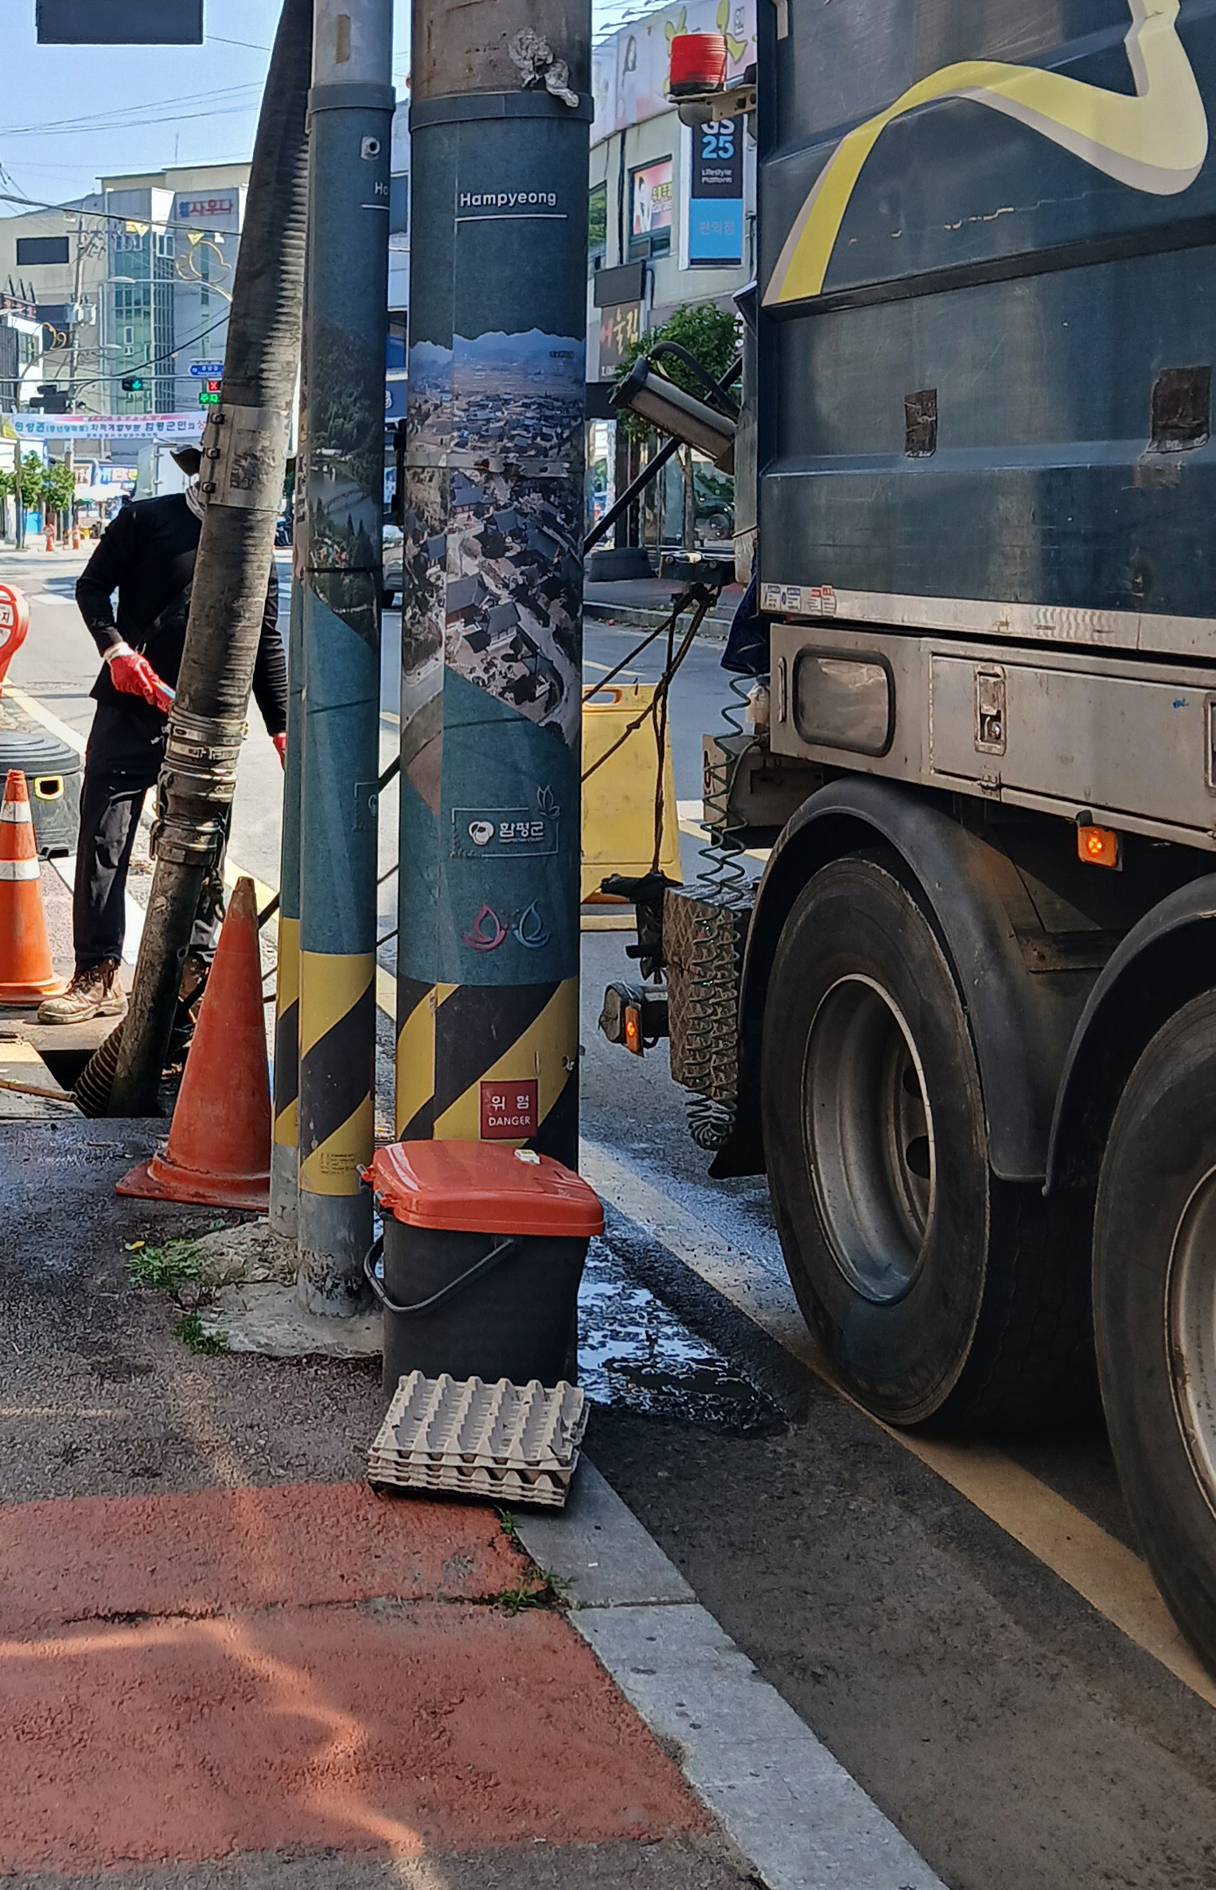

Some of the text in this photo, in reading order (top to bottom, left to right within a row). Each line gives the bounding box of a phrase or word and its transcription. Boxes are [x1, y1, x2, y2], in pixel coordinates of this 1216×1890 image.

[701, 135, 734, 159] 25
[190, 199, 233, 216] 사우나
[460, 192, 557, 207] Hampyeong
[499, 822, 544, 838] 함평군
[488, 1115, 531, 1127] DANGER
